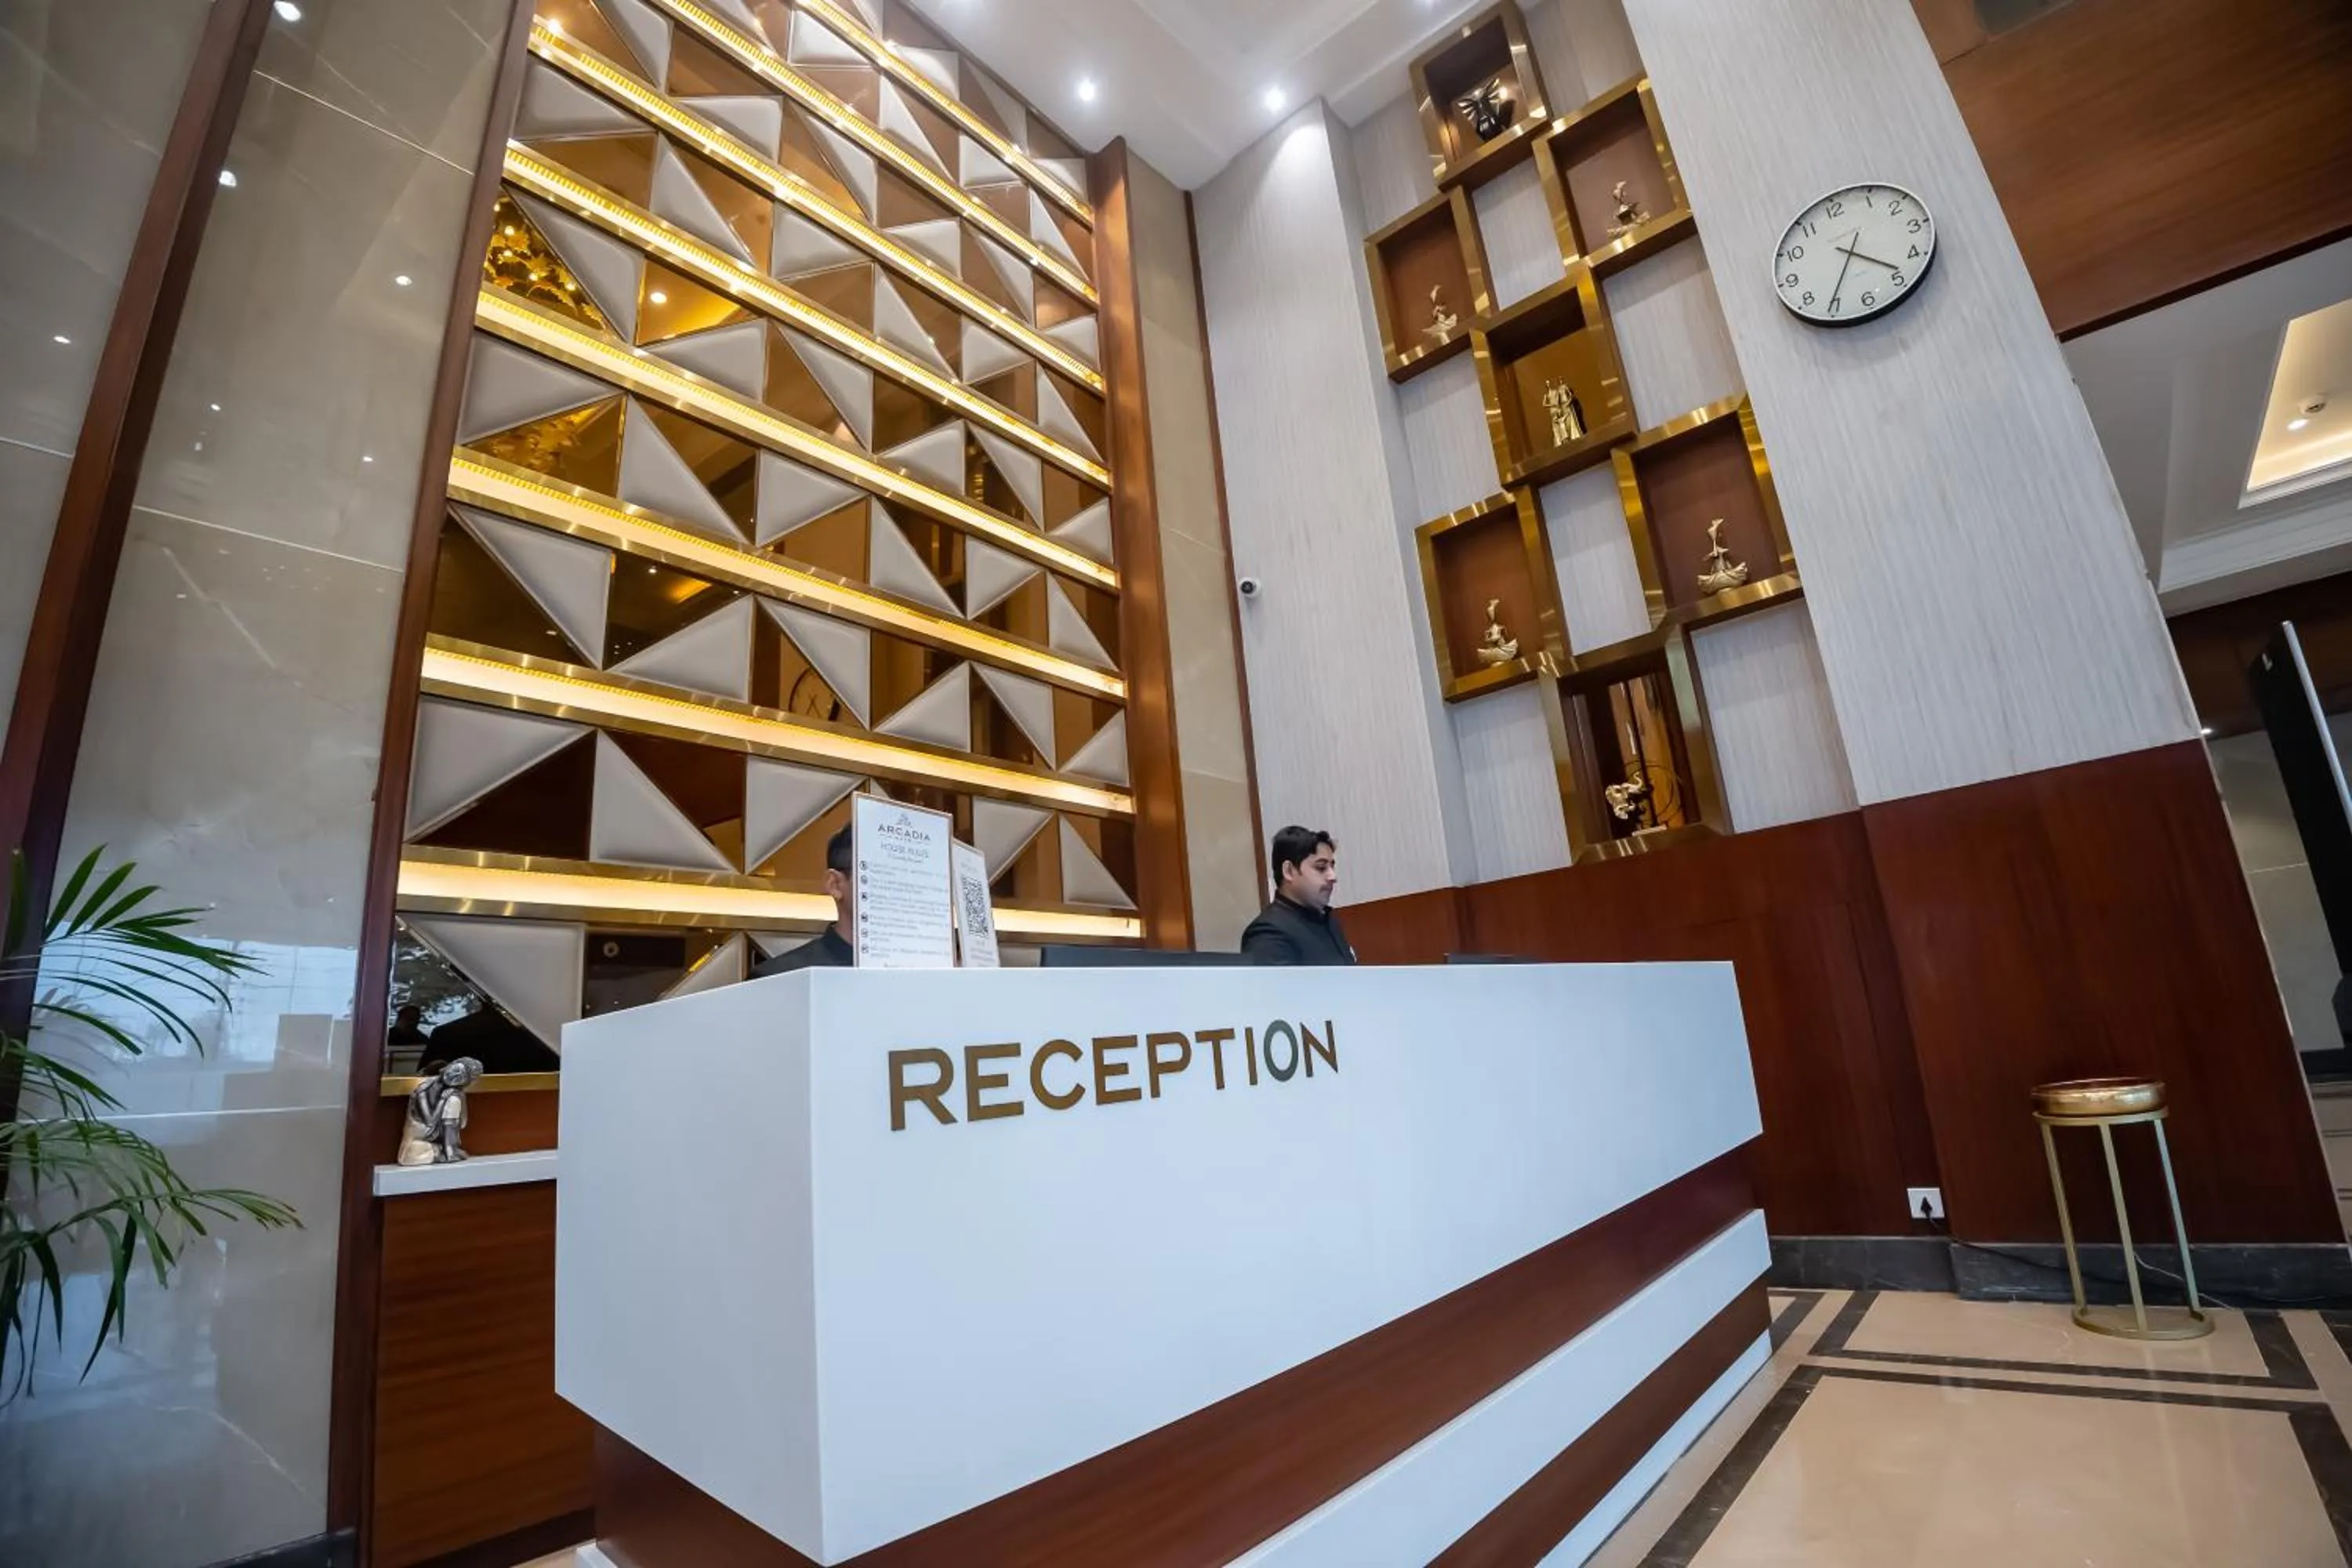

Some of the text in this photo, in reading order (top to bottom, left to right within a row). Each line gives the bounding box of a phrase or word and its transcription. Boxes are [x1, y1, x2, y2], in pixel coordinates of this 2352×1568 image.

[1865, 195, 1873, 209] 1
[1889, 200, 1902, 216] 2
[1826, 202, 1844, 220] 12
[1802, 223, 1817, 238] 11
[1907, 219, 1922, 234] 3
[1786, 245, 1804, 262] 10
[1907, 244, 1920, 260] 4
[1785, 274, 1798, 288] 9
[1891, 270, 1905, 286] 5
[1802, 291, 1815, 306] 8
[1860, 292, 1875, 307] 6
[877, 823, 931, 842] ARCADIA
[888, 1019, 1338, 1131] RECEPTION
